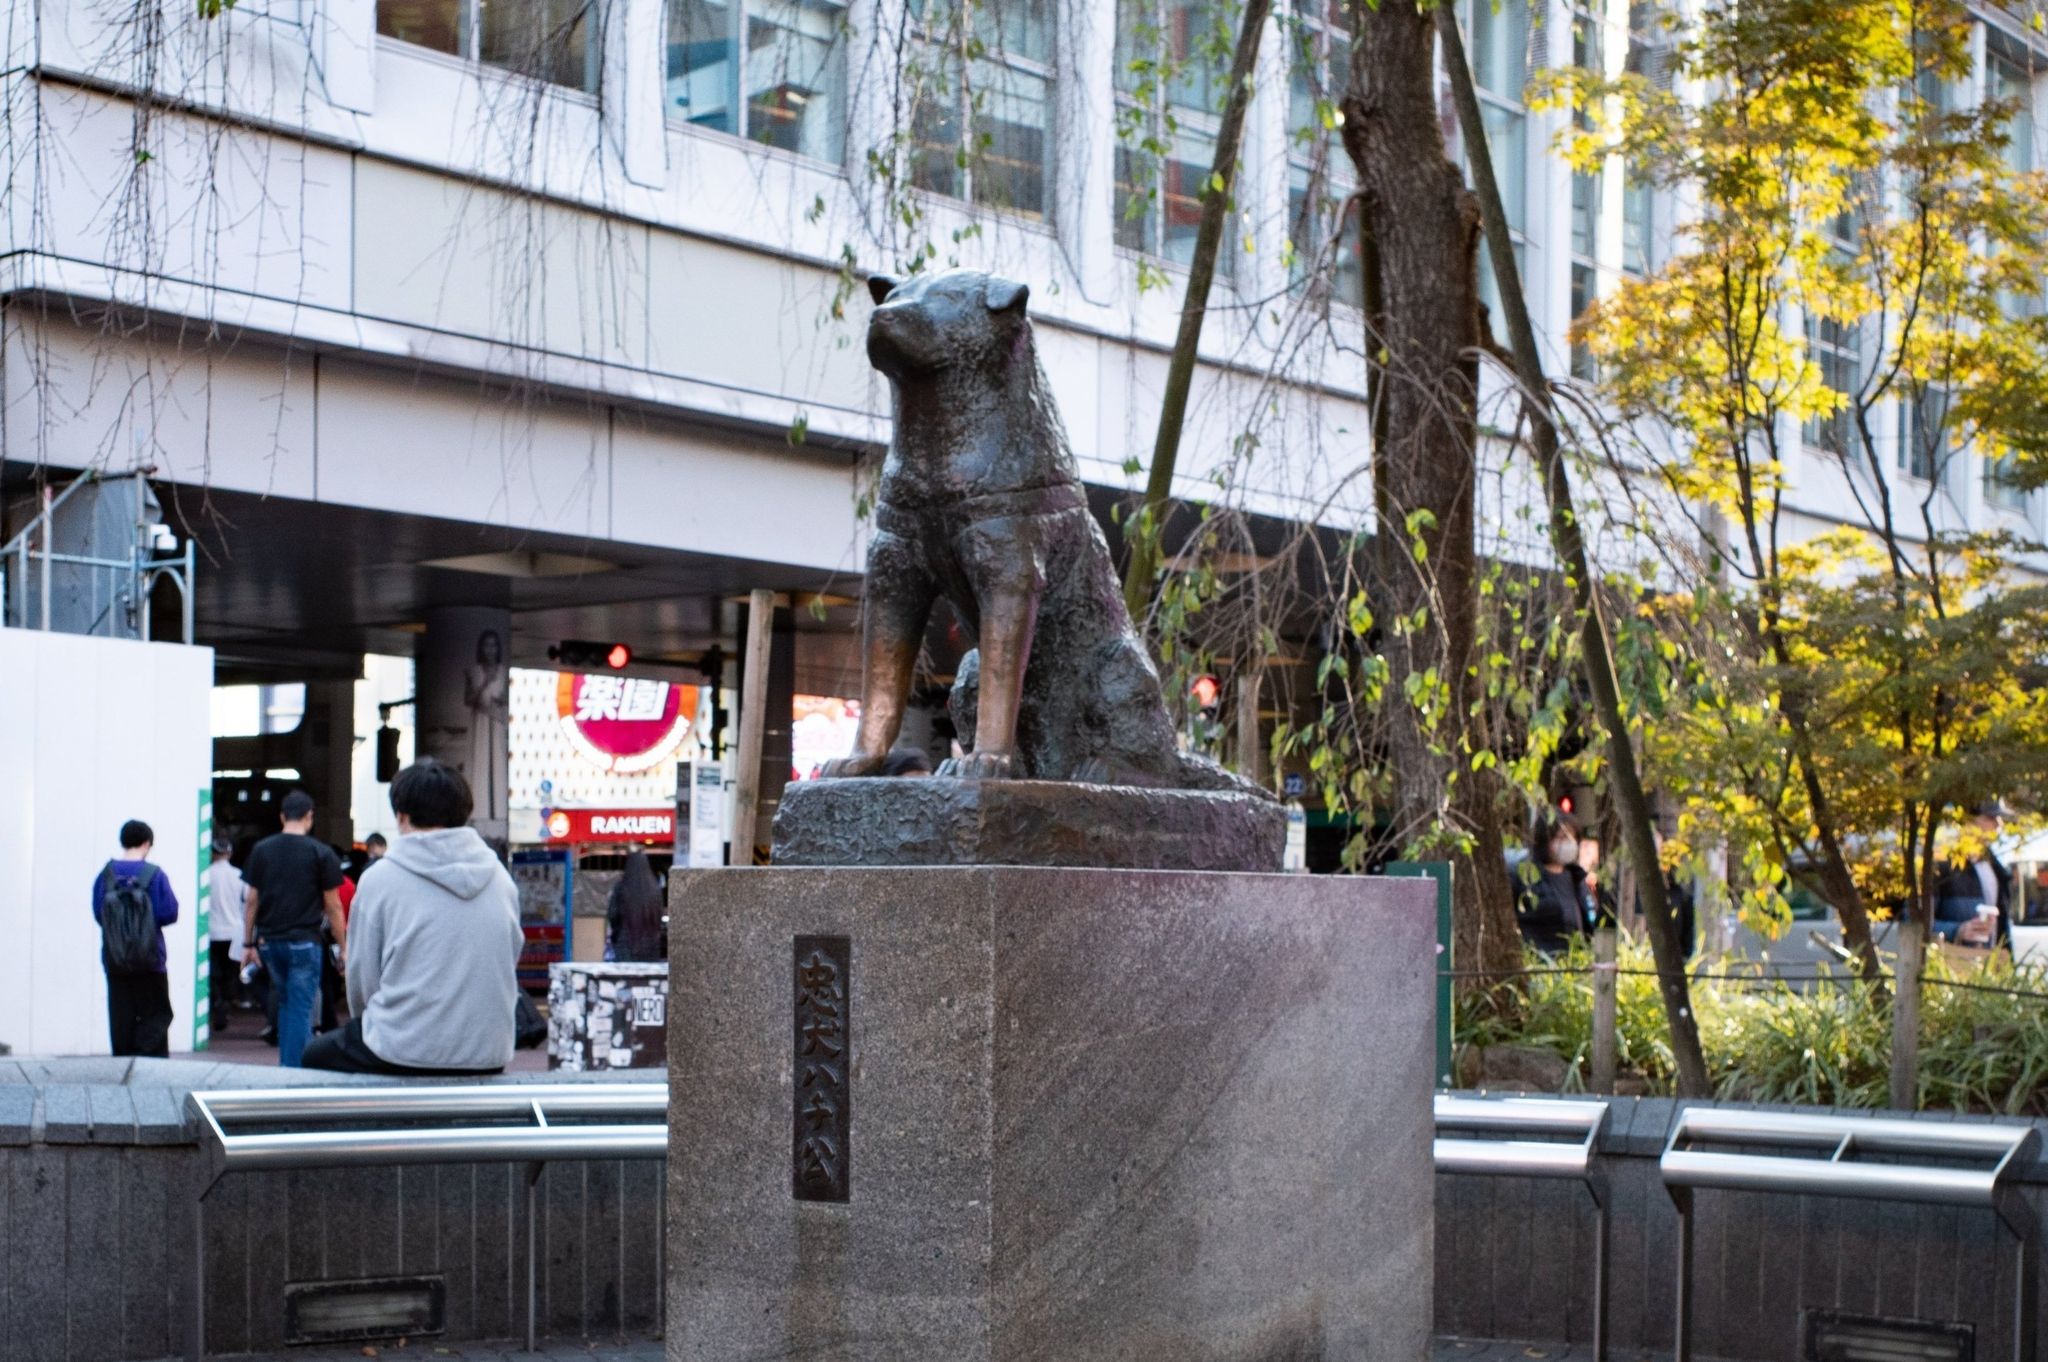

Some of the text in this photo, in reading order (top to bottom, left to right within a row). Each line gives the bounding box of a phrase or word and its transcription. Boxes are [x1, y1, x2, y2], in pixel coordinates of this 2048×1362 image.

[575, 674, 670, 720] 楽園
[591, 816, 671, 834] RAKUEN
[798, 950, 843, 1185] 忠犬ハチ公
